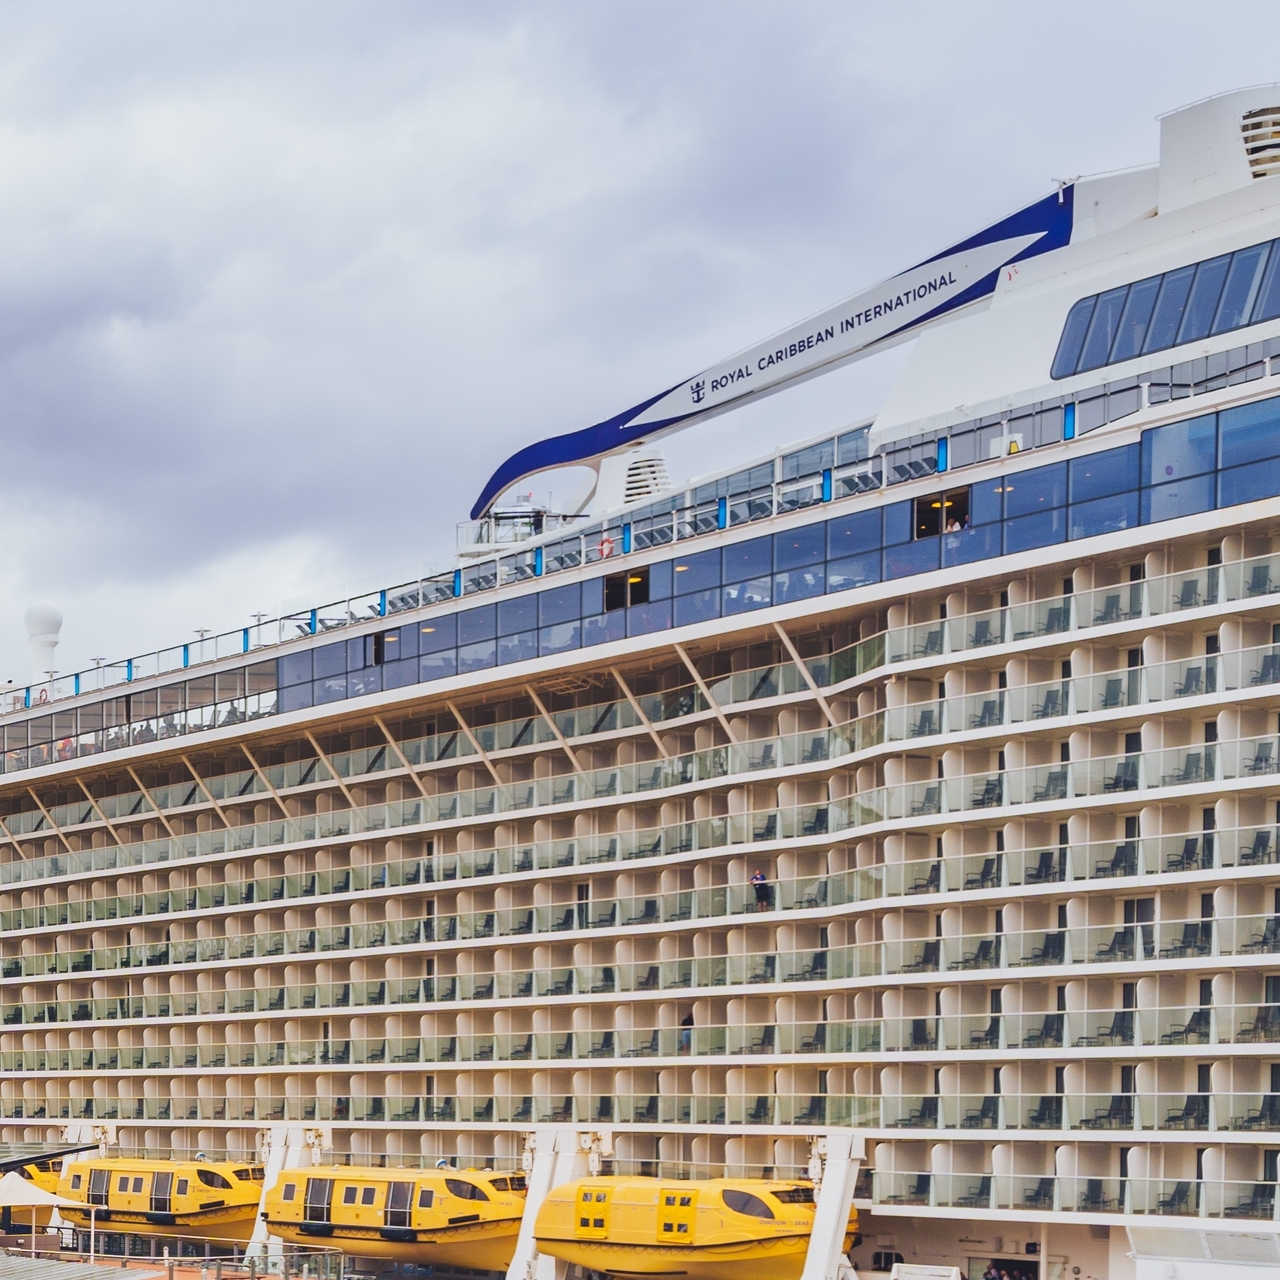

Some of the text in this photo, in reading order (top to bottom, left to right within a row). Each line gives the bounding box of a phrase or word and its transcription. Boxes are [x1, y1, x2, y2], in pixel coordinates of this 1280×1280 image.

[711, 271, 957, 393] ROYAL CARIBBEAN INTERNATIONAL
